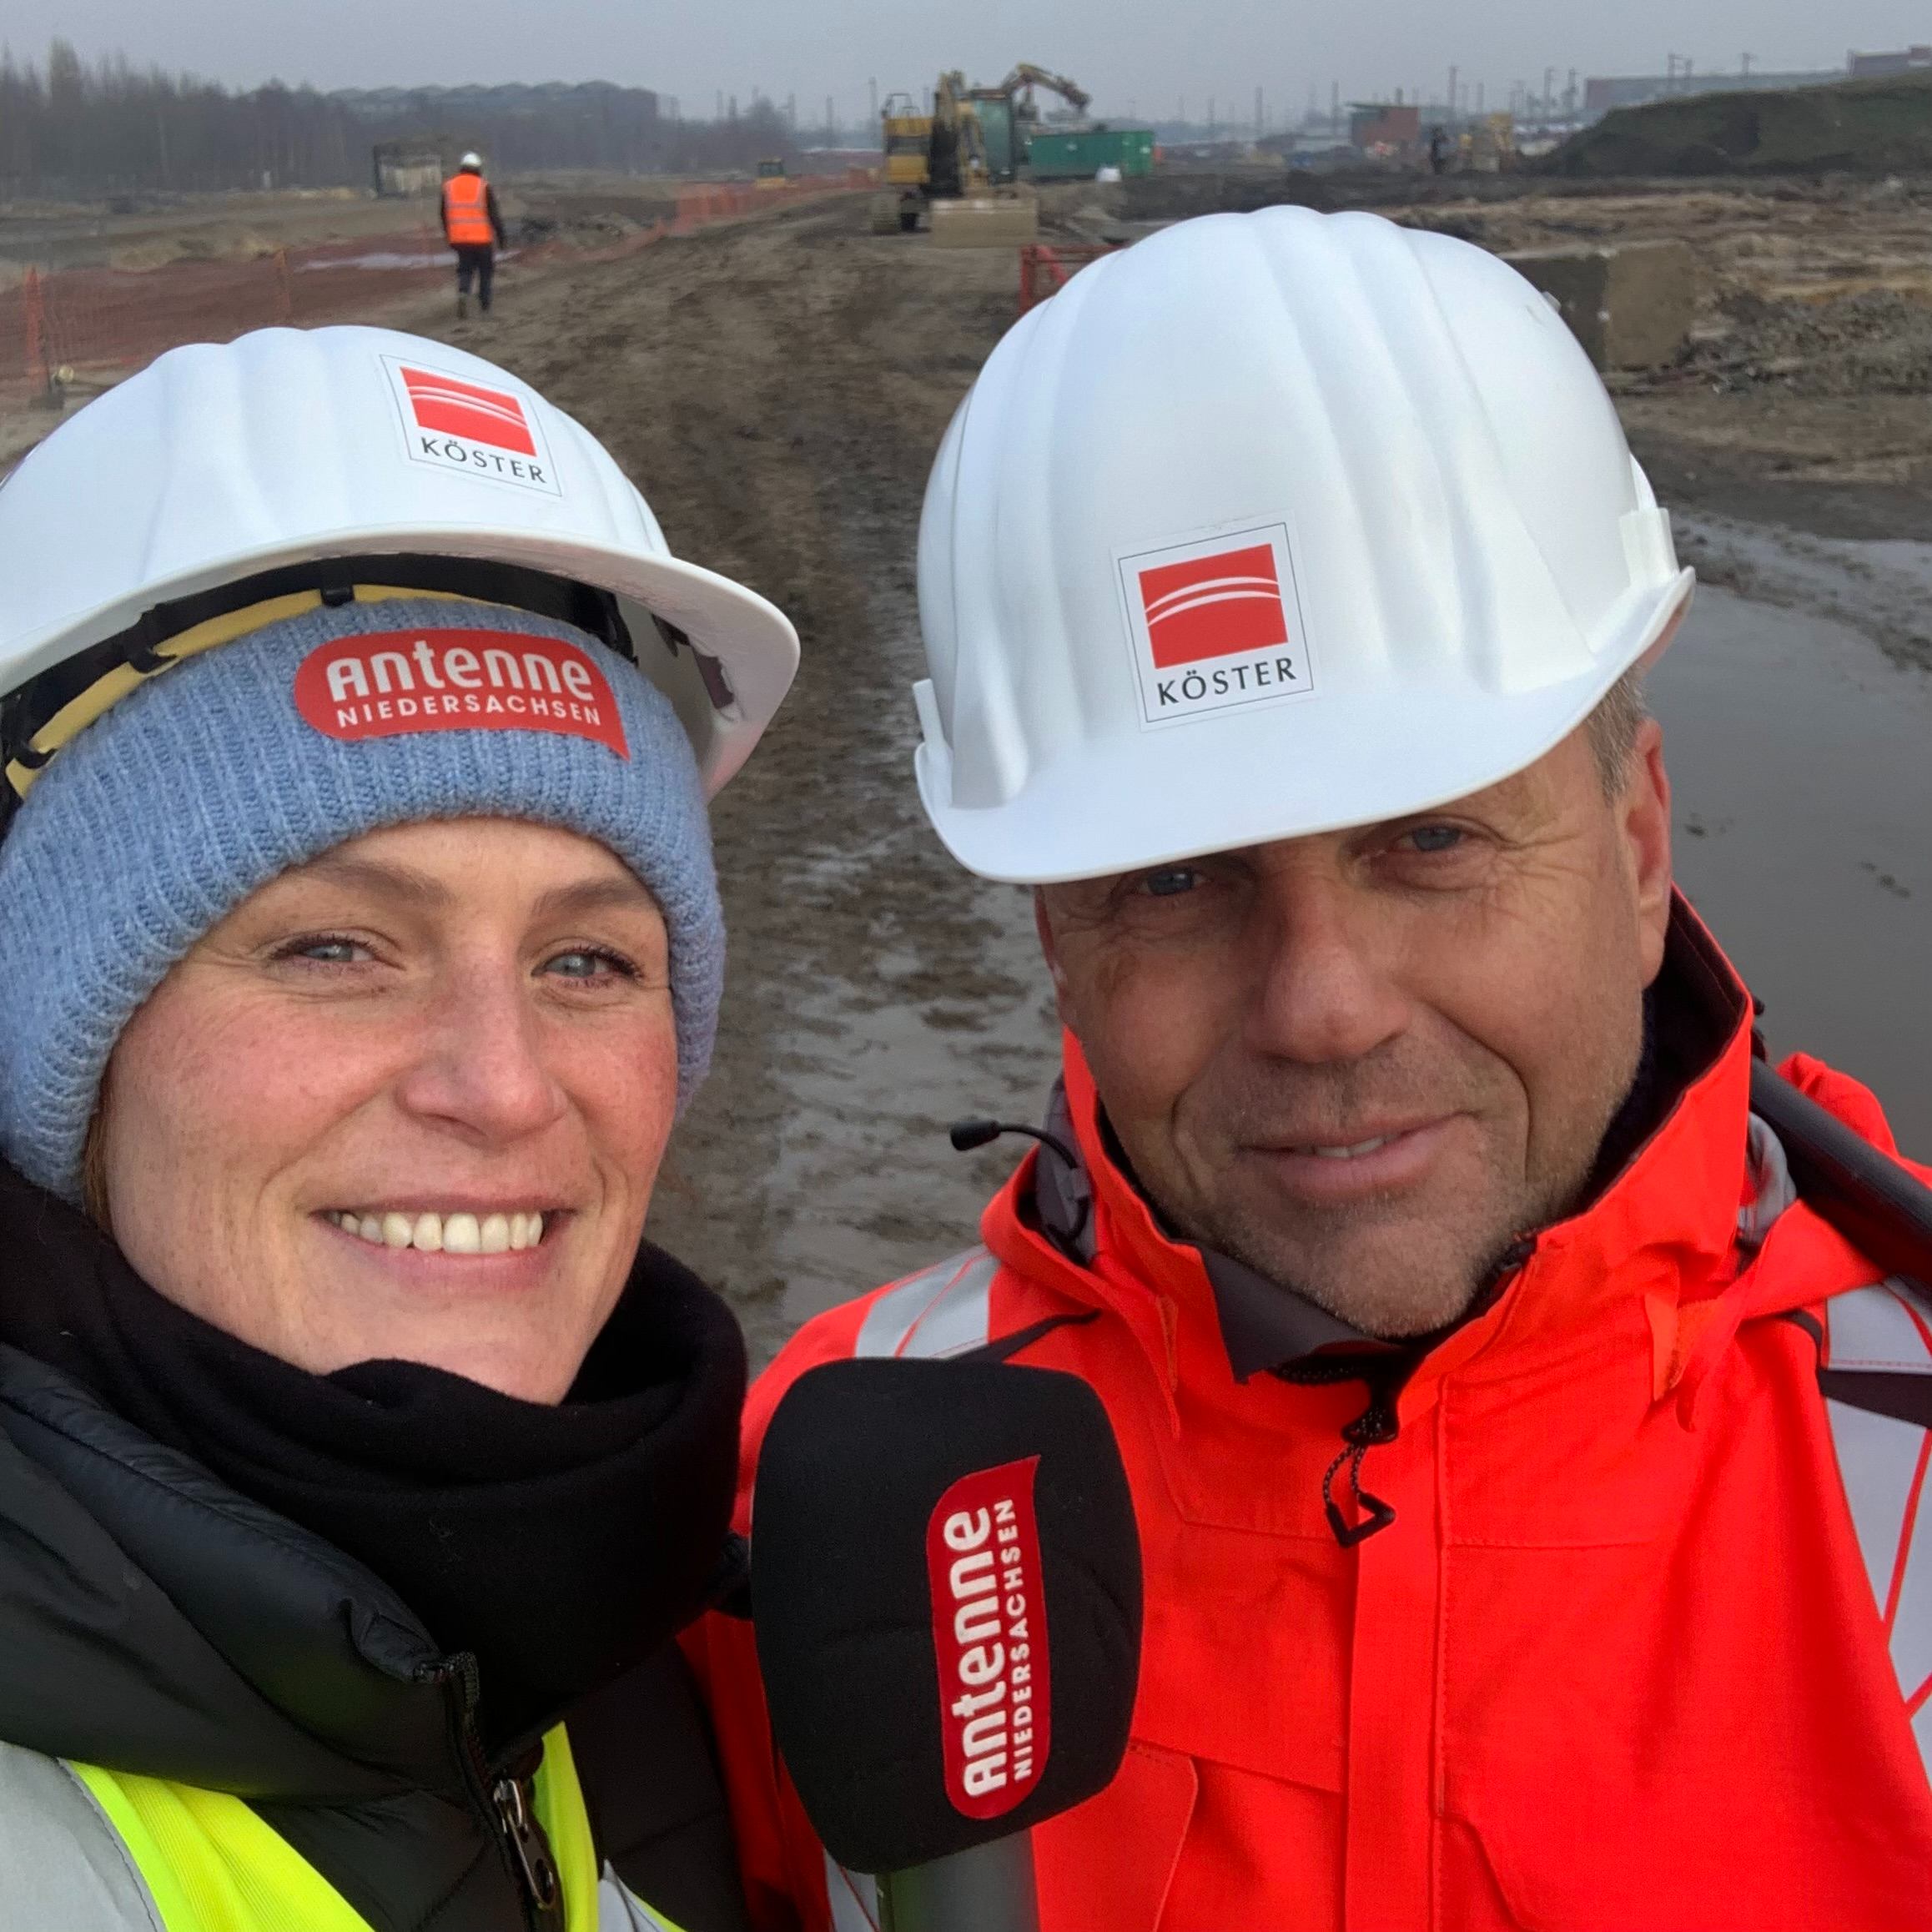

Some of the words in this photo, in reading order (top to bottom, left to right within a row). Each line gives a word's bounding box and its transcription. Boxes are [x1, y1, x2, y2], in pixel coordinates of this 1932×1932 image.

[421, 436, 546, 484] KÖSTER
[1157, 657, 1297, 706] KÖSTER
[337, 694, 601, 728] NIEDERSACHSEN
[994, 1498, 1034, 1783] NIEDERSACHSEN
